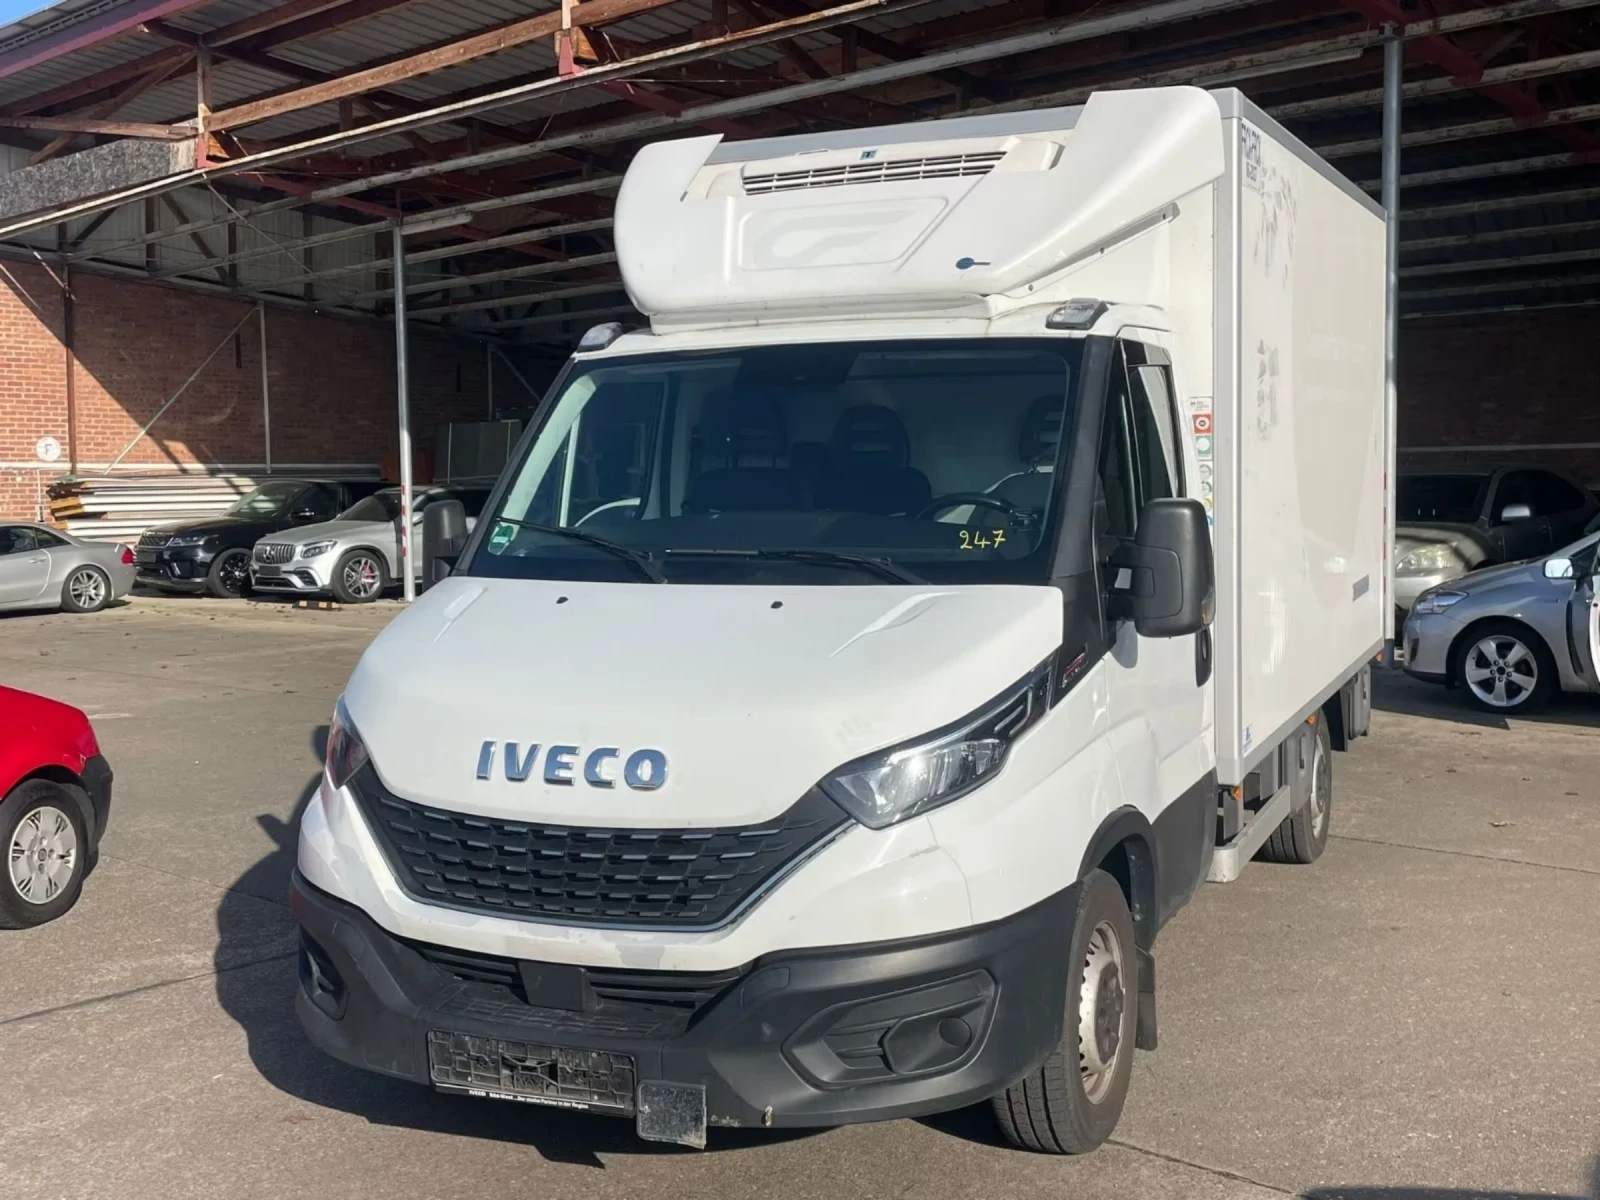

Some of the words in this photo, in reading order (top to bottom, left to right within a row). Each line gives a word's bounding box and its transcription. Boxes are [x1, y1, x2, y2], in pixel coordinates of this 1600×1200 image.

[959, 530, 1006, 549] 247
[476, 740, 669, 792] IVECO
[469, 1089, 486, 1097] IVECO
[572, 1102, 589, 1110] Region
